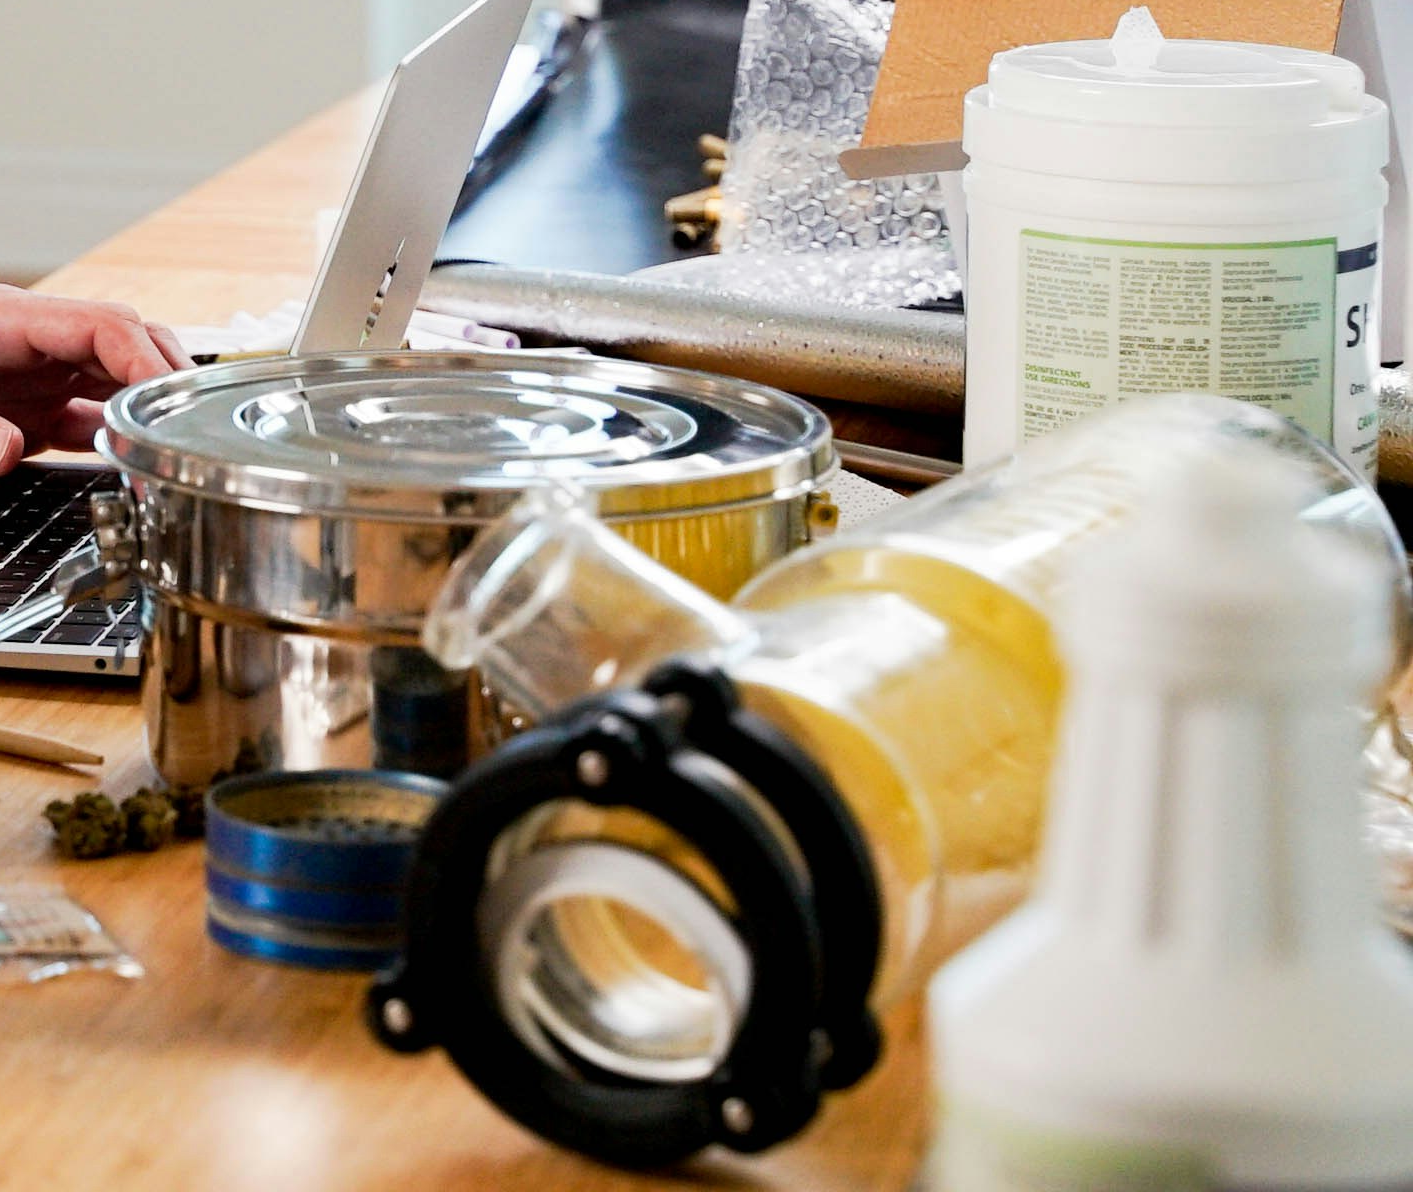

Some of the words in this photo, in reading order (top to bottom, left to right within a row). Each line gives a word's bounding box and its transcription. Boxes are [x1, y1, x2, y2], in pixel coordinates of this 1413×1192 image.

[1025, 363, 1081, 378] DISINFECTANT
[1025, 373, 1038, 381] USE
[1041, 375, 1091, 389] DIRECTIONS
